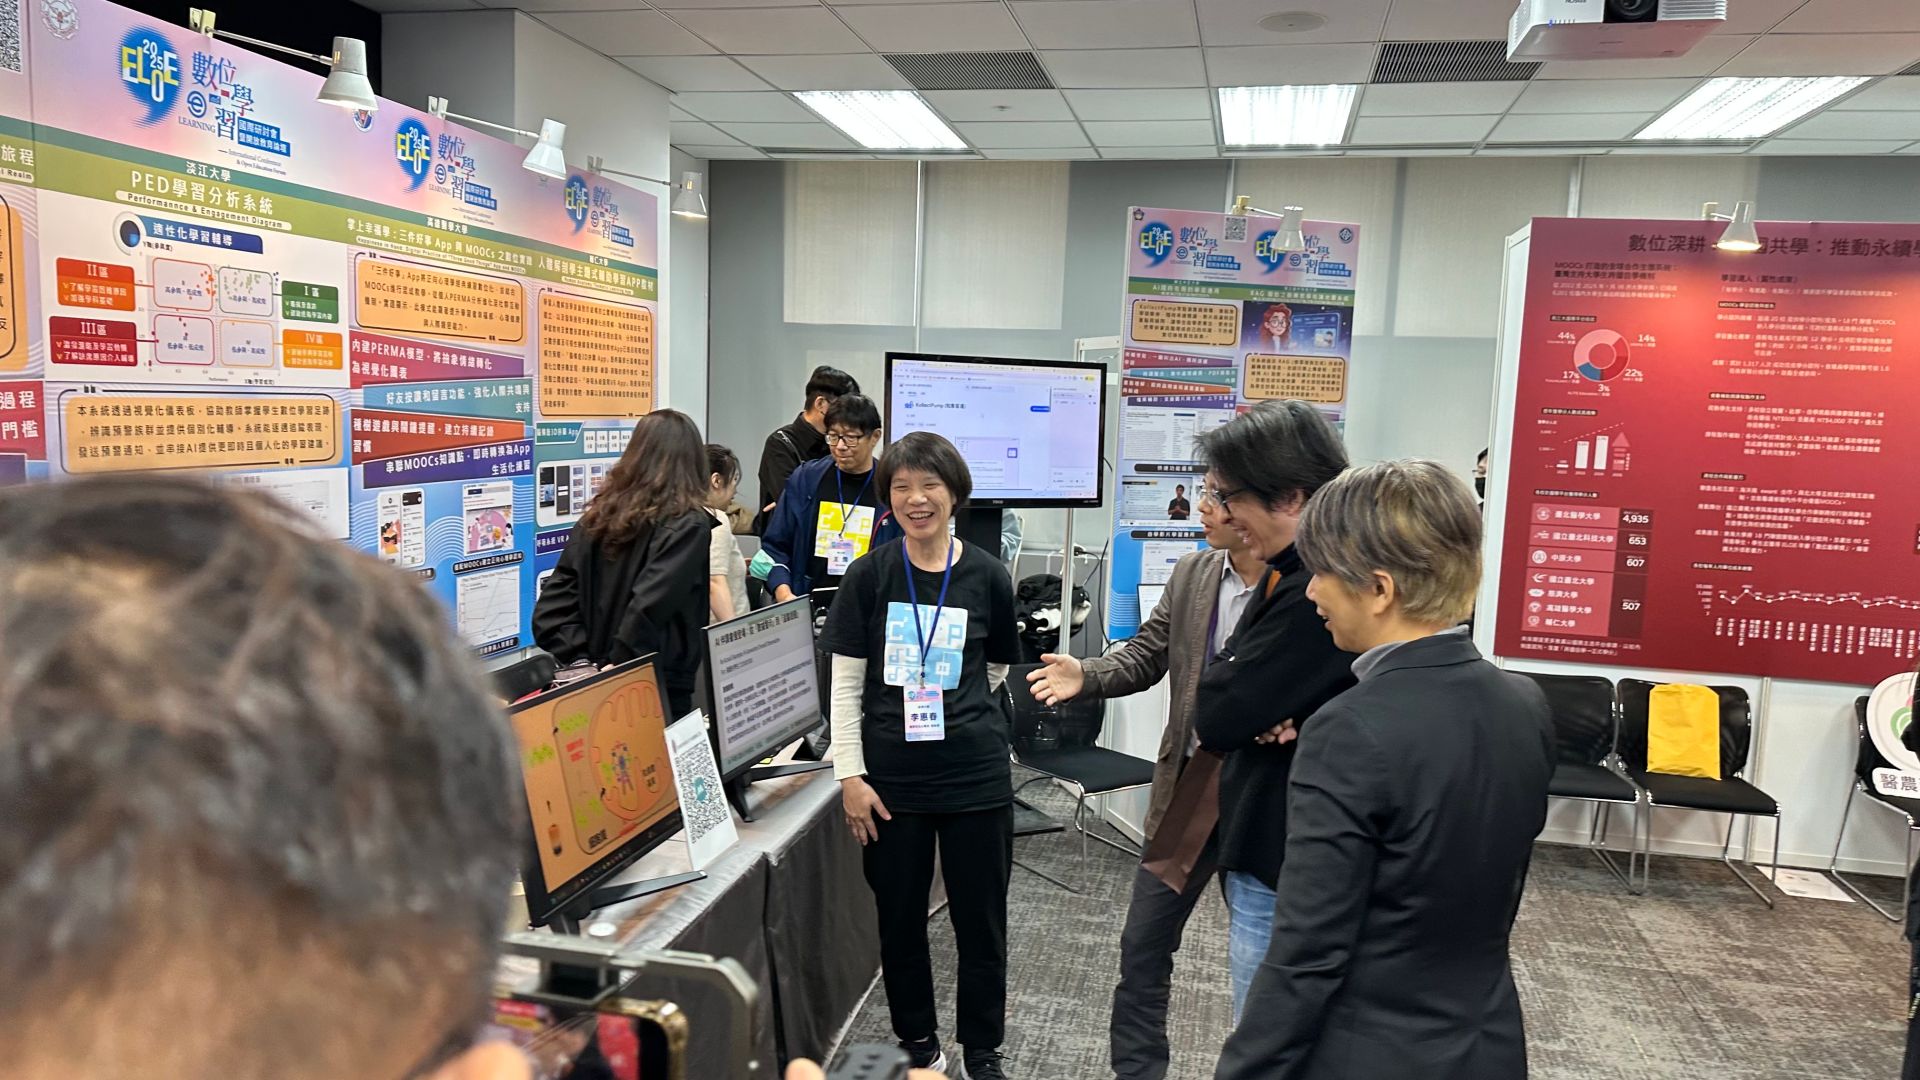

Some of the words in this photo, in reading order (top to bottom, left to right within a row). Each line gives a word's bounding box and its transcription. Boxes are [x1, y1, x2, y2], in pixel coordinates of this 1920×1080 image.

[178, 116, 216, 134] LEARNING
[1, 145, 35, 167] 旅程
[186, 161, 231, 182] 淡江大學
[131, 170, 273, 216] PED學習分析系統
[128, 193, 188, 212] Performannce
[200, 207, 249, 223] Engagement
[251, 216, 283, 229] Diagram
[427, 217, 469, 234] 高雄醫學大學
[152, 222, 233, 247] 適性化學習輔導
[434, 238, 452, 252] App
[465, 243, 495, 259] MOOCs
[1558, 332, 1576, 340] 44%
[1638, 334, 1656, 342] 14%
[351, 360, 408, 380] 為視覺化圖表
[1562, 371, 1580, 379] 17%
[1624, 369, 1643, 377] 22%
[1598, 384, 1610, 392] 3%
[515, 402, 530, 414] 支持
[1, 420, 39, 440] 門檻
[353, 439, 372, 453] 習慣
[491, 459, 531, 476] 生活化練習
[1622, 515, 1649, 524] 4,935
[1628, 537, 1647, 545] 653
[1626, 558, 1645, 567] 607
[1622, 602, 1640, 611] 507
